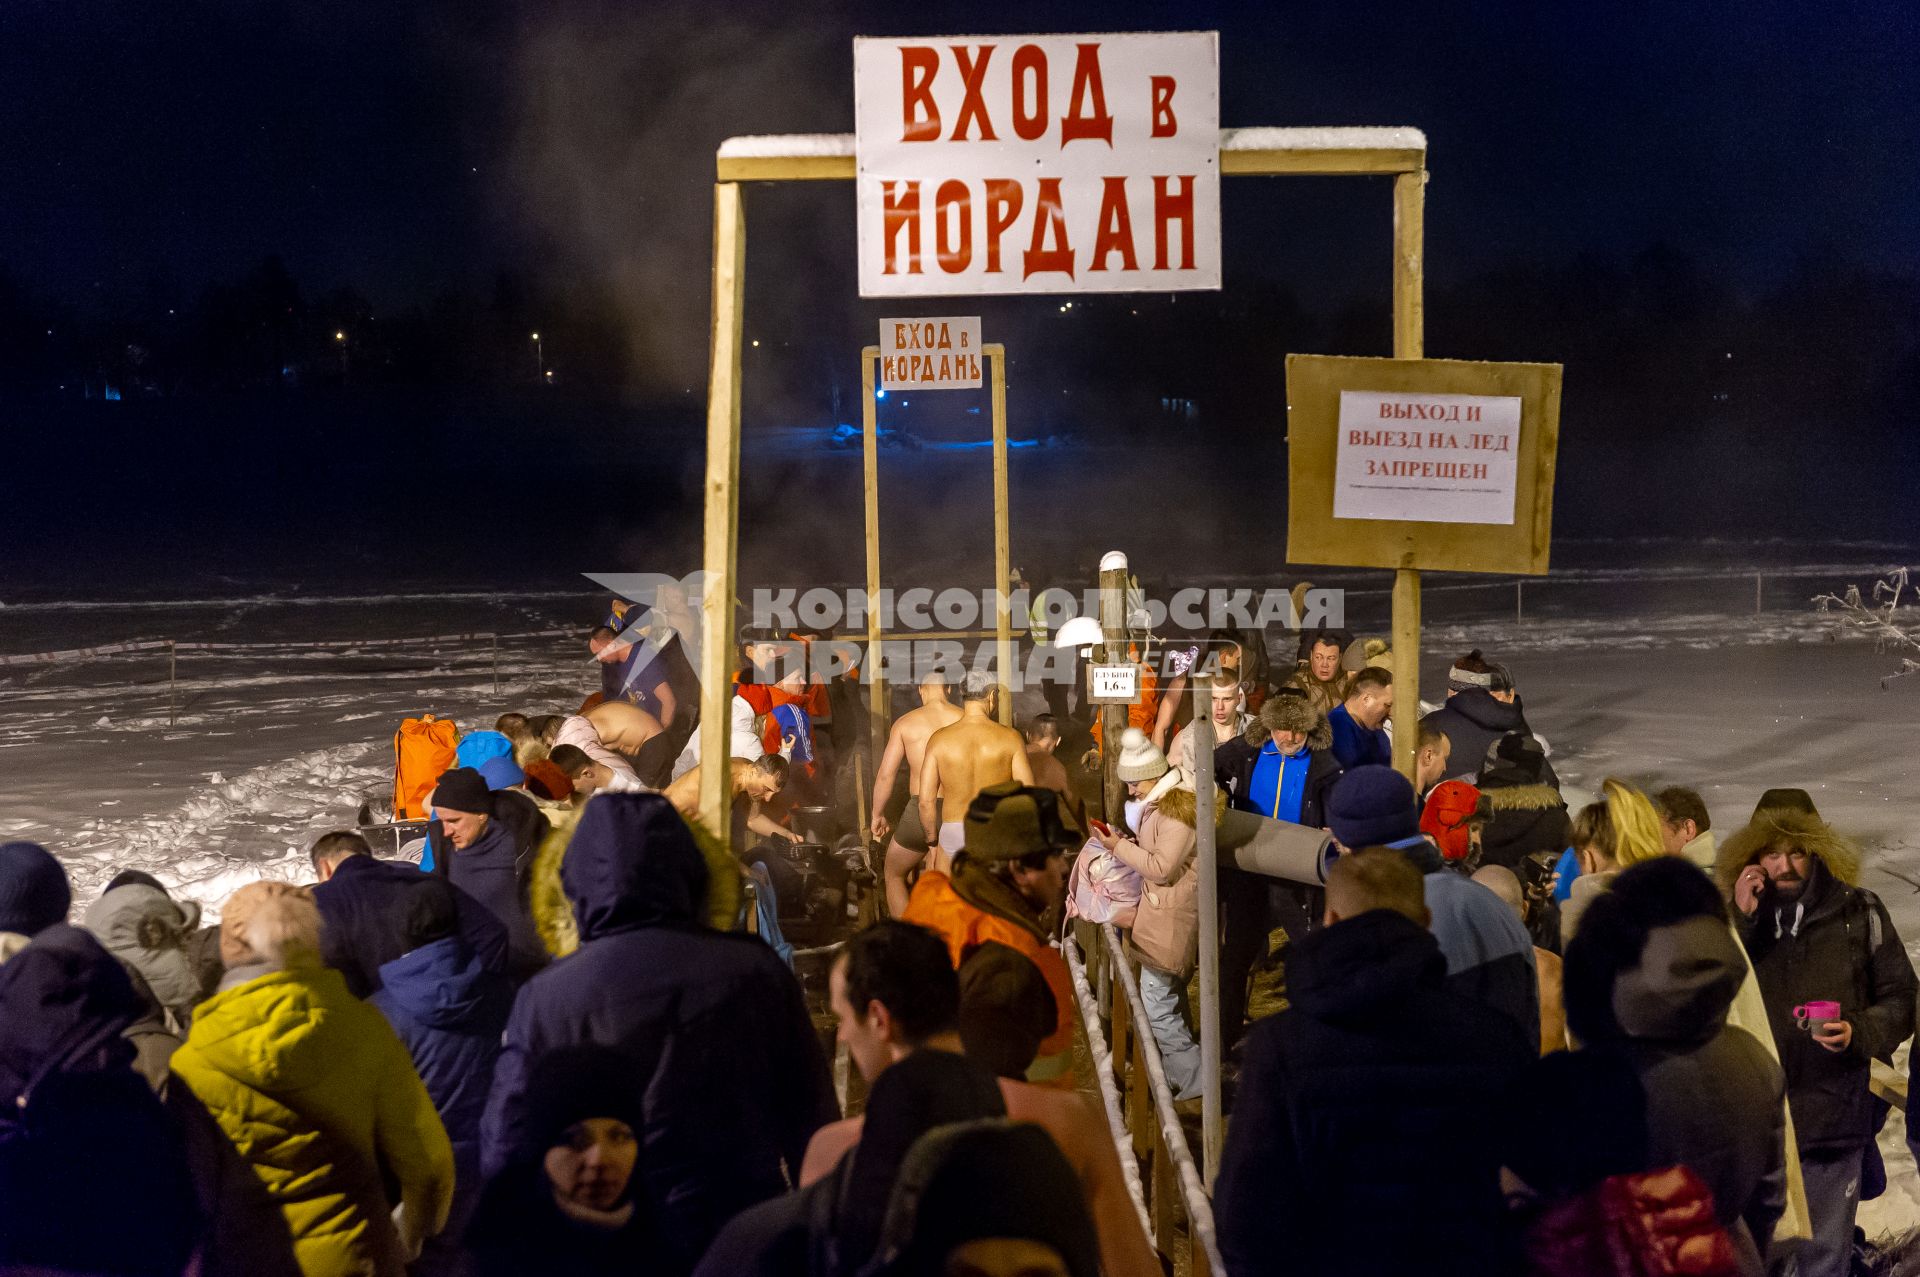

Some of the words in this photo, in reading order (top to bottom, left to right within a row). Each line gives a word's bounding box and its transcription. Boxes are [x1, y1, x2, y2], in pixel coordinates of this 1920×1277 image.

[898, 43, 1114, 150] ВХОД
[880, 175, 1198, 283] ИОРДАН
[883, 353, 981, 383] ИОРДАНЬ
[1379, 402, 1460, 423] ВЫХОД
[1466, 405, 1482, 422] И
[1348, 429, 1423, 449] ВЫЕЗД
[1428, 432, 1459, 449] НА
[1464, 433, 1510, 452] ЛЕД
[1365, 459, 1488, 480] ЗАПРЕЩЕН
[1103, 681, 1119, 692] 1,6
